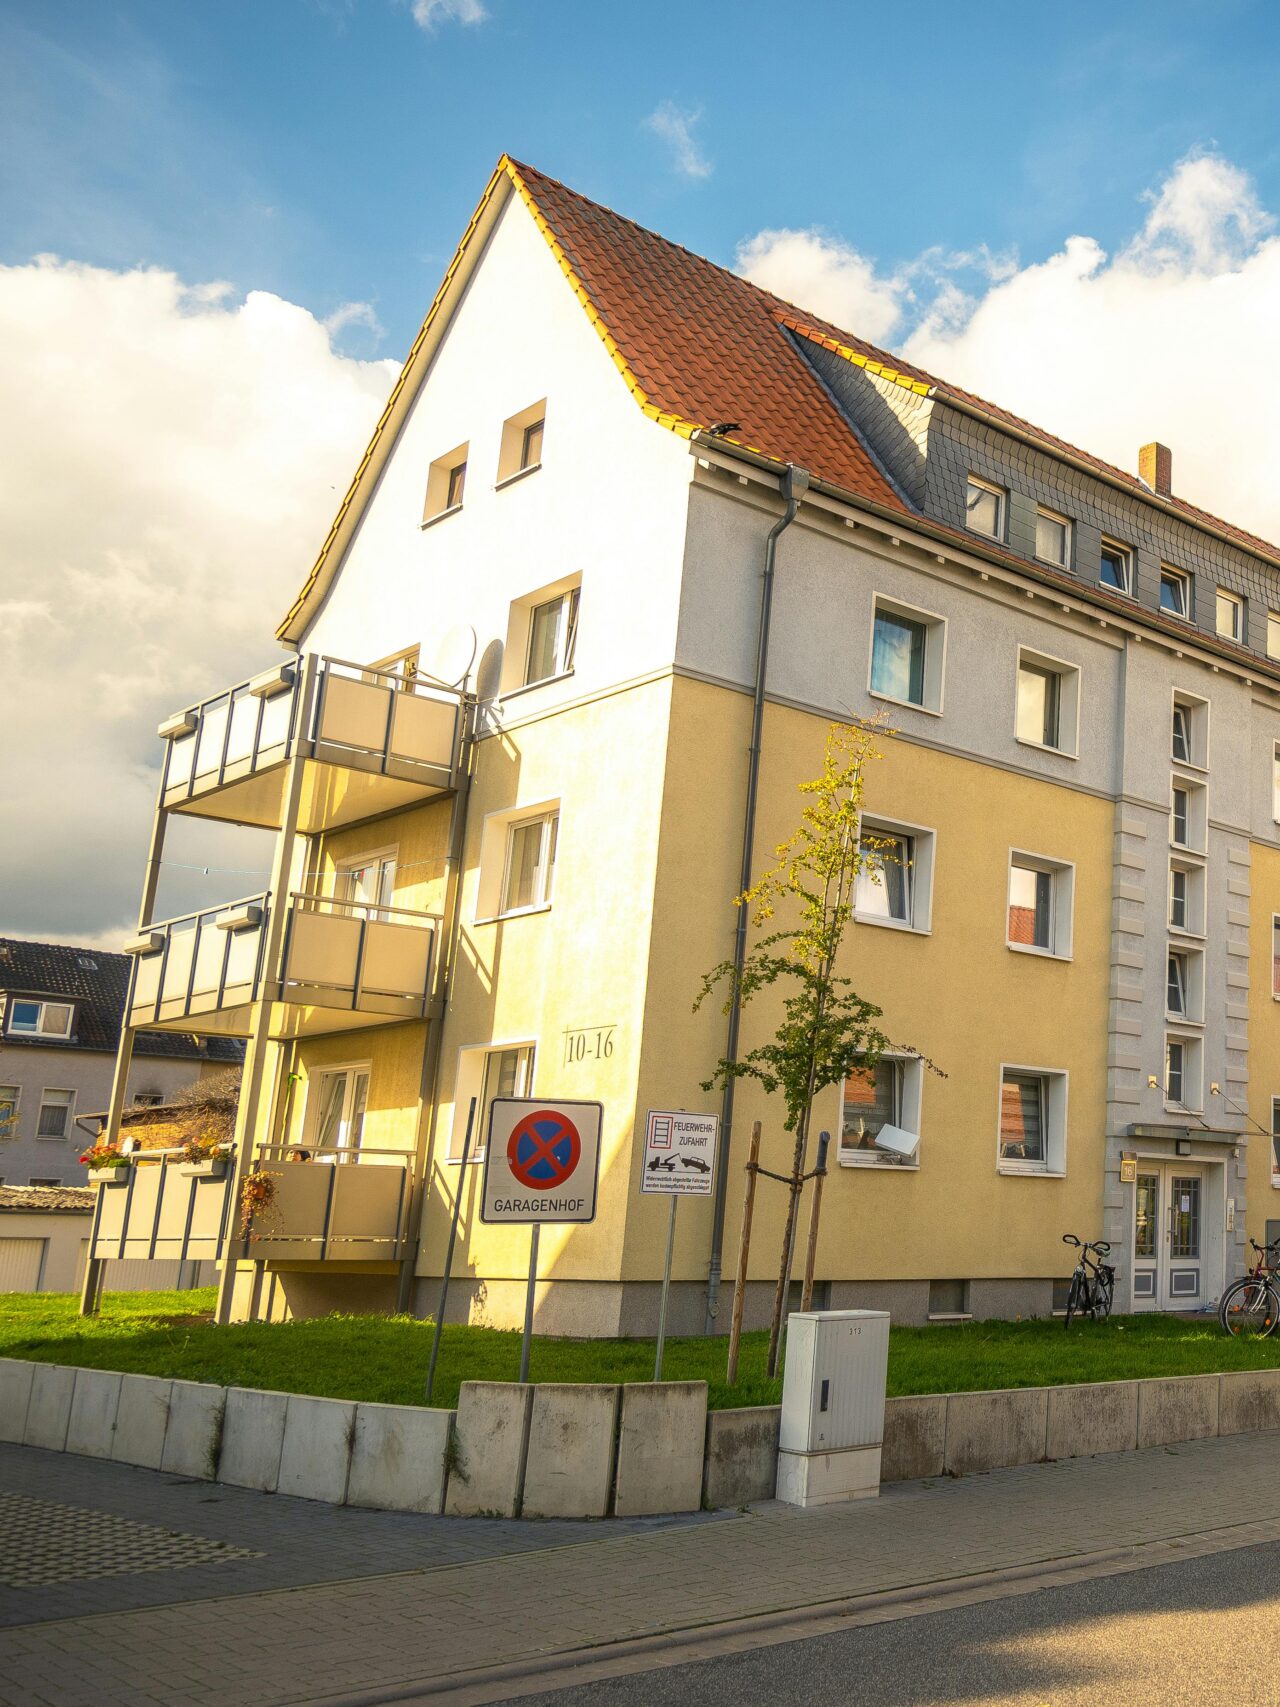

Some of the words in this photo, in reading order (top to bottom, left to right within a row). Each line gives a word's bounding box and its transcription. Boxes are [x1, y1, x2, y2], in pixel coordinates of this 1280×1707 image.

[567, 1029, 614, 1063] 10-16
[674, 1122, 715, 1132] FEUERWEHR-
[679, 1136, 708, 1147] ZUFAHRT
[1124, 1166, 1133, 1176] 16
[494, 1199, 585, 1212] GARAGENHOF
[849, 1327, 862, 1335] 313
